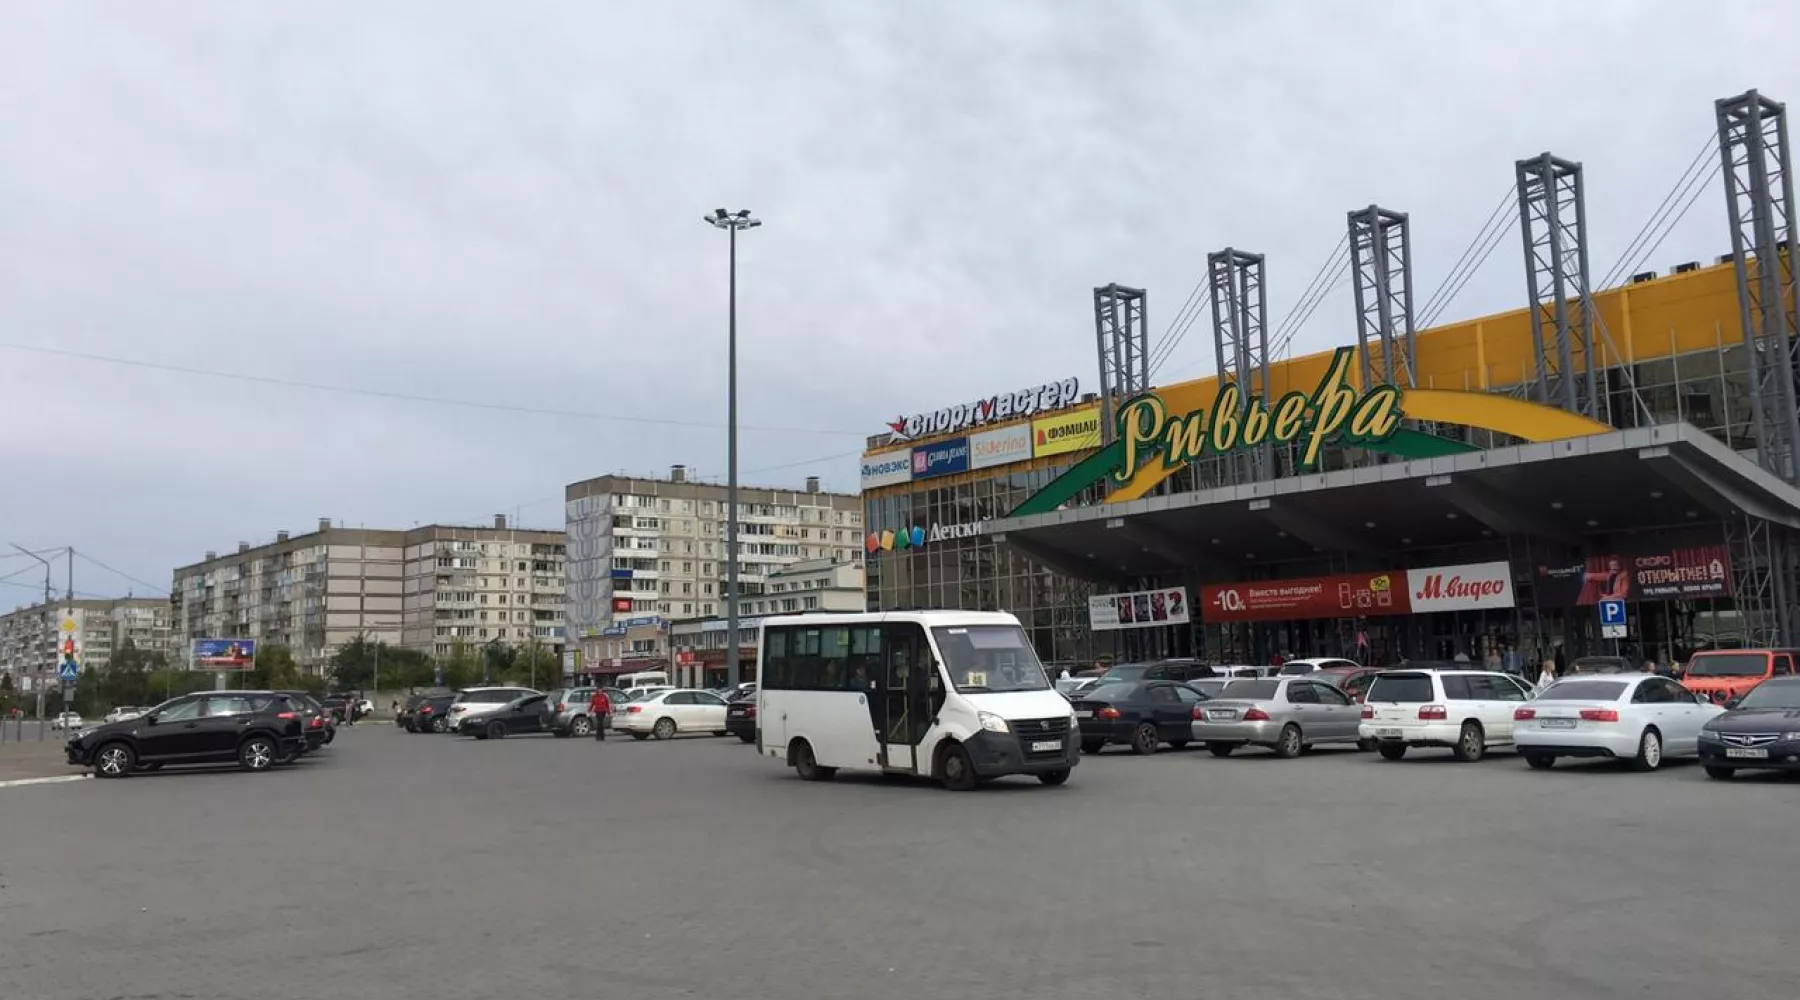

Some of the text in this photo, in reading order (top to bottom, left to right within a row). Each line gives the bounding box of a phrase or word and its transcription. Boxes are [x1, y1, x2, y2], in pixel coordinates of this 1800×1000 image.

[1113, 345, 1401, 482] Ривьера
[871, 459, 909, 477] НОВЭКС
[929, 515, 991, 542] Детски
[1416, 574, 1504, 601] М.видео
[1606, 603, 1619, 622] P
